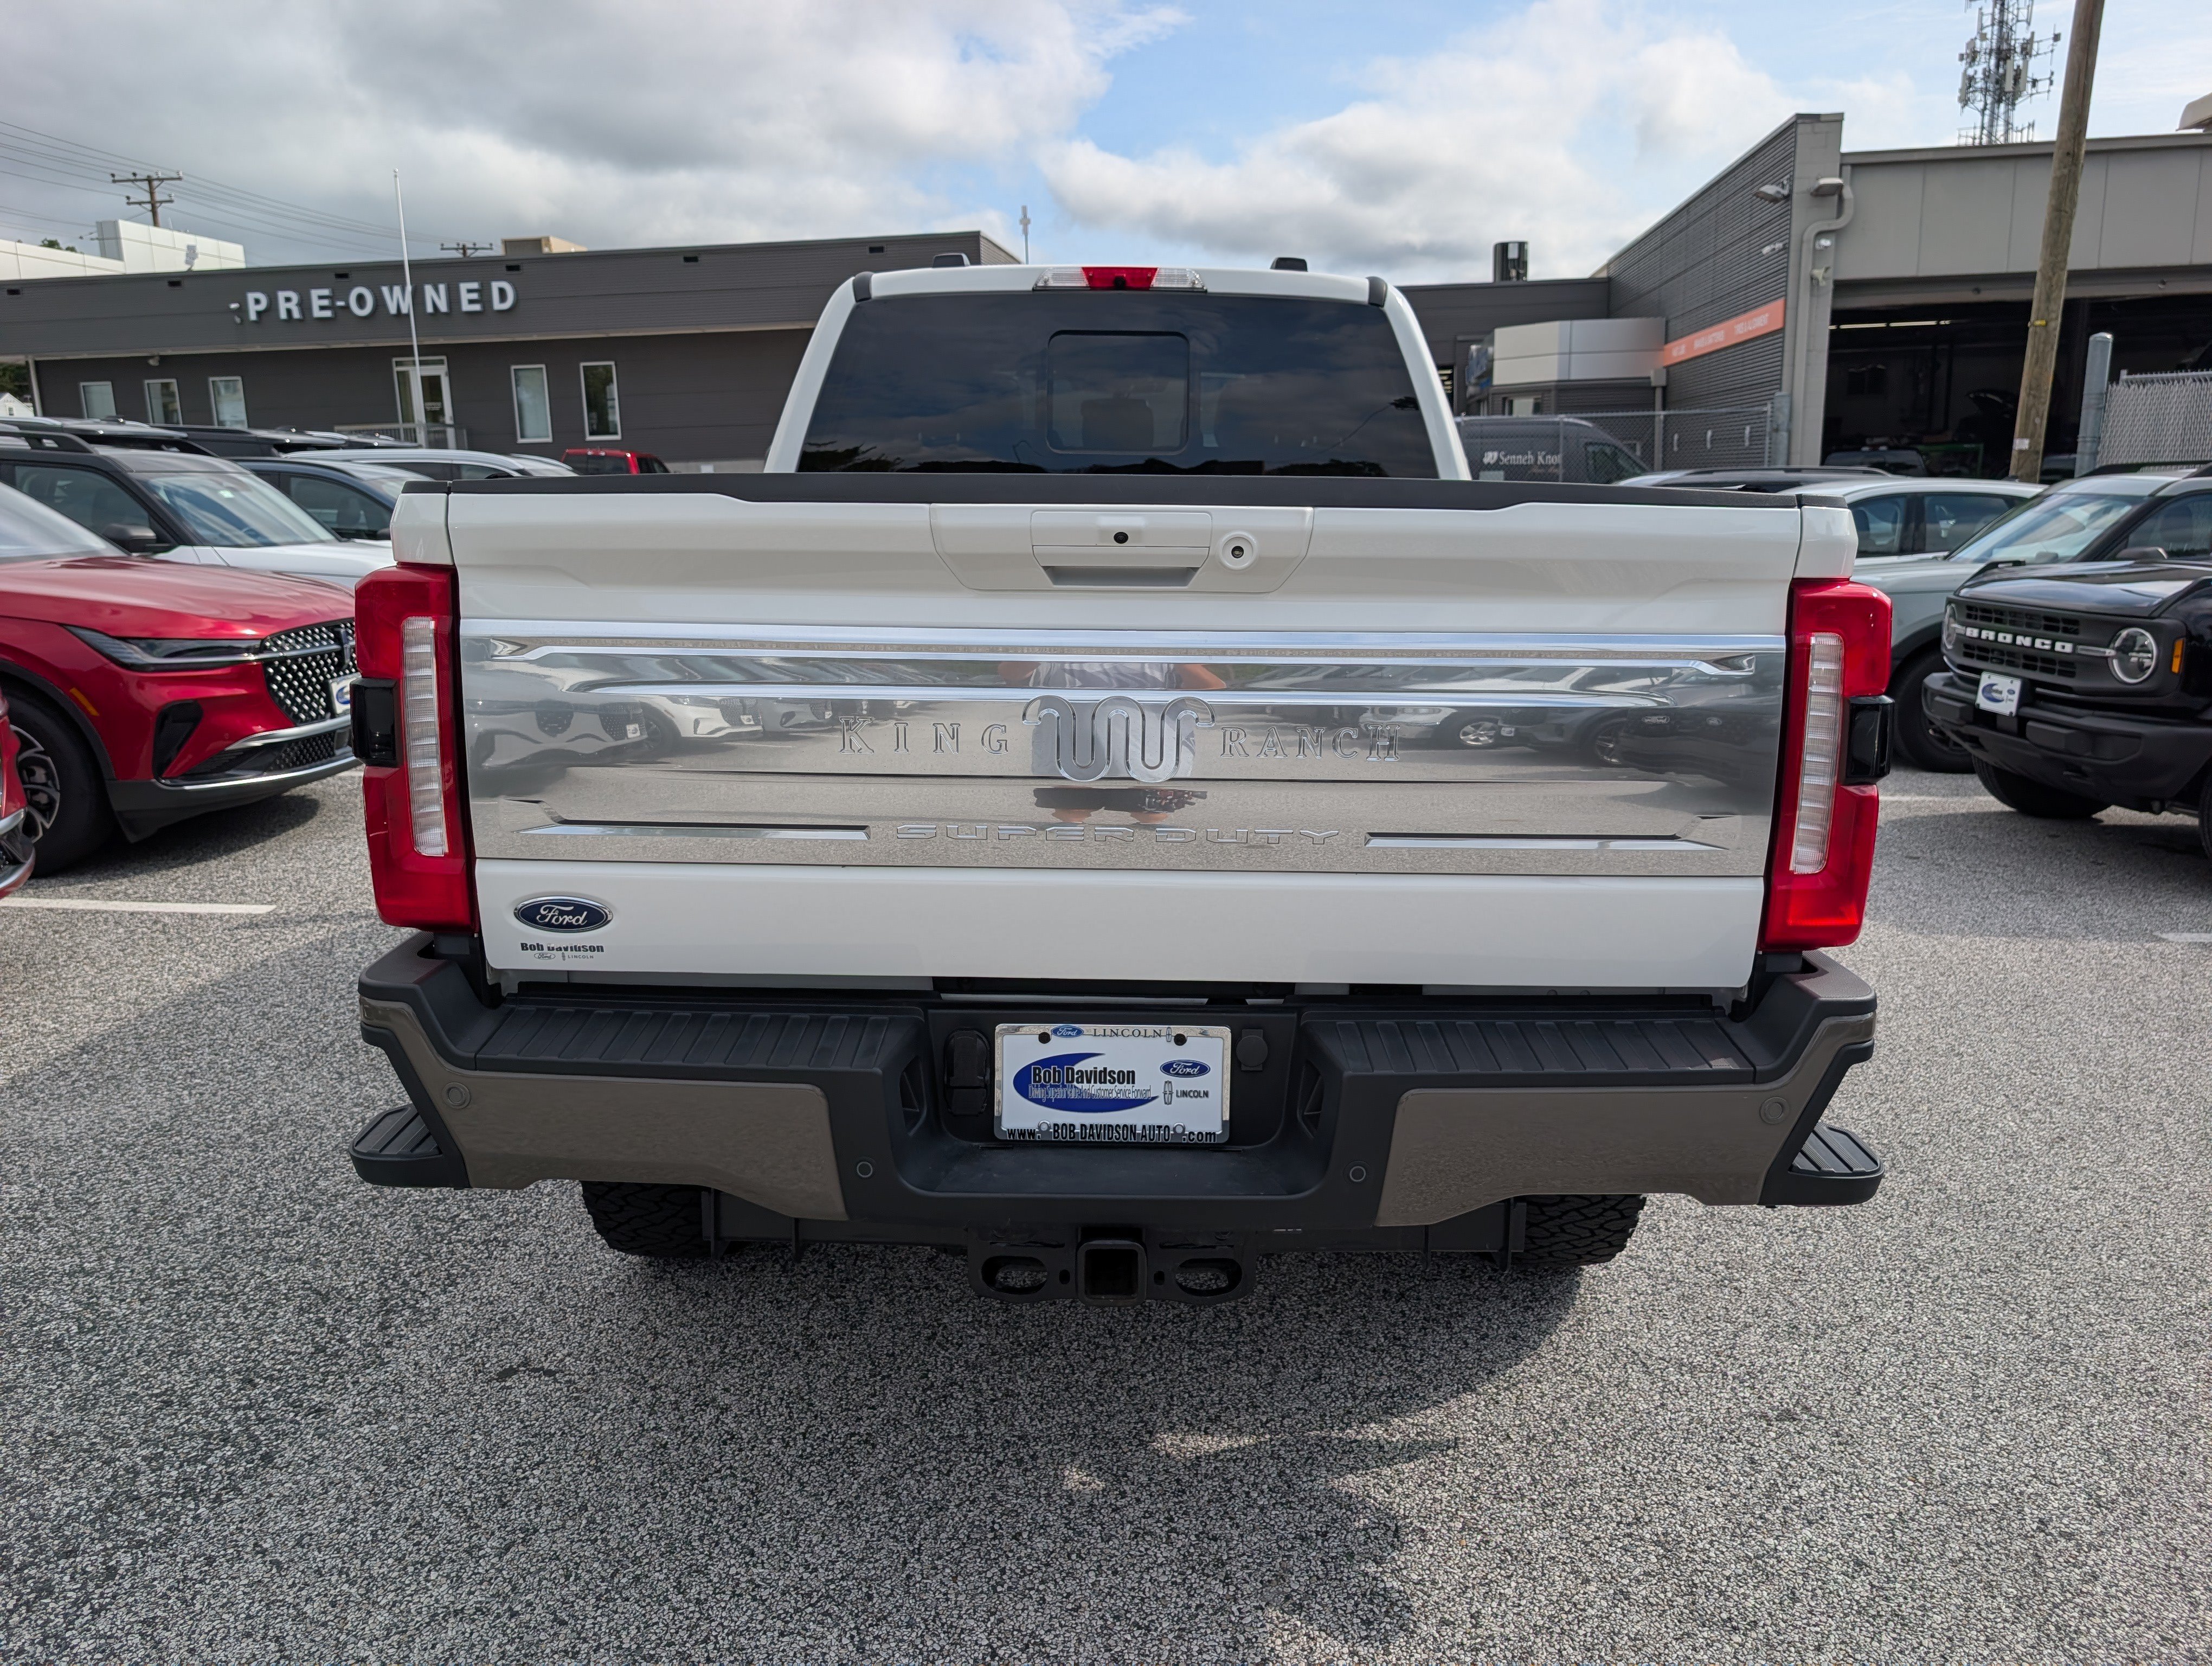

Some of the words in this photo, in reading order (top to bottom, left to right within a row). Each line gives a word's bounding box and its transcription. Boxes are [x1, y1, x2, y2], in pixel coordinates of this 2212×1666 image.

[246, 280, 517, 322] PRE-OWNED
[1965, 628, 2074, 653] BRONCO
[839, 716, 1009, 754] KING
[1220, 723, 1401, 762] RANCH
[896, 824, 1135, 843] SUPER
[1155, 828, 1340, 845] DUTY
[536, 904, 588, 926] Ford
[520, 943, 544, 951] Bob
[1057, 1027, 1078, 1036] Ford
[1092, 1028, 1162, 1038] LINCOLN
[1032, 1066, 1062, 1084] Bob
[1065, 1066, 1136, 1085] Davidson
[1169, 1061, 1200, 1075] Ford
[1046, 1085, 1066, 1102] Superior
[1091, 1085, 1114, 1099] Customer
[1114, 1085, 1131, 1099] Service
[1131, 1085, 1152, 1099] Forward
[1175, 1089, 1210, 1098] LINCOLN
[1053, 1123, 1076, 1140] BOB
[1079, 1123, 1137, 1142] DAVIDSON
[1140, 1124, 1171, 1142] AUTO
